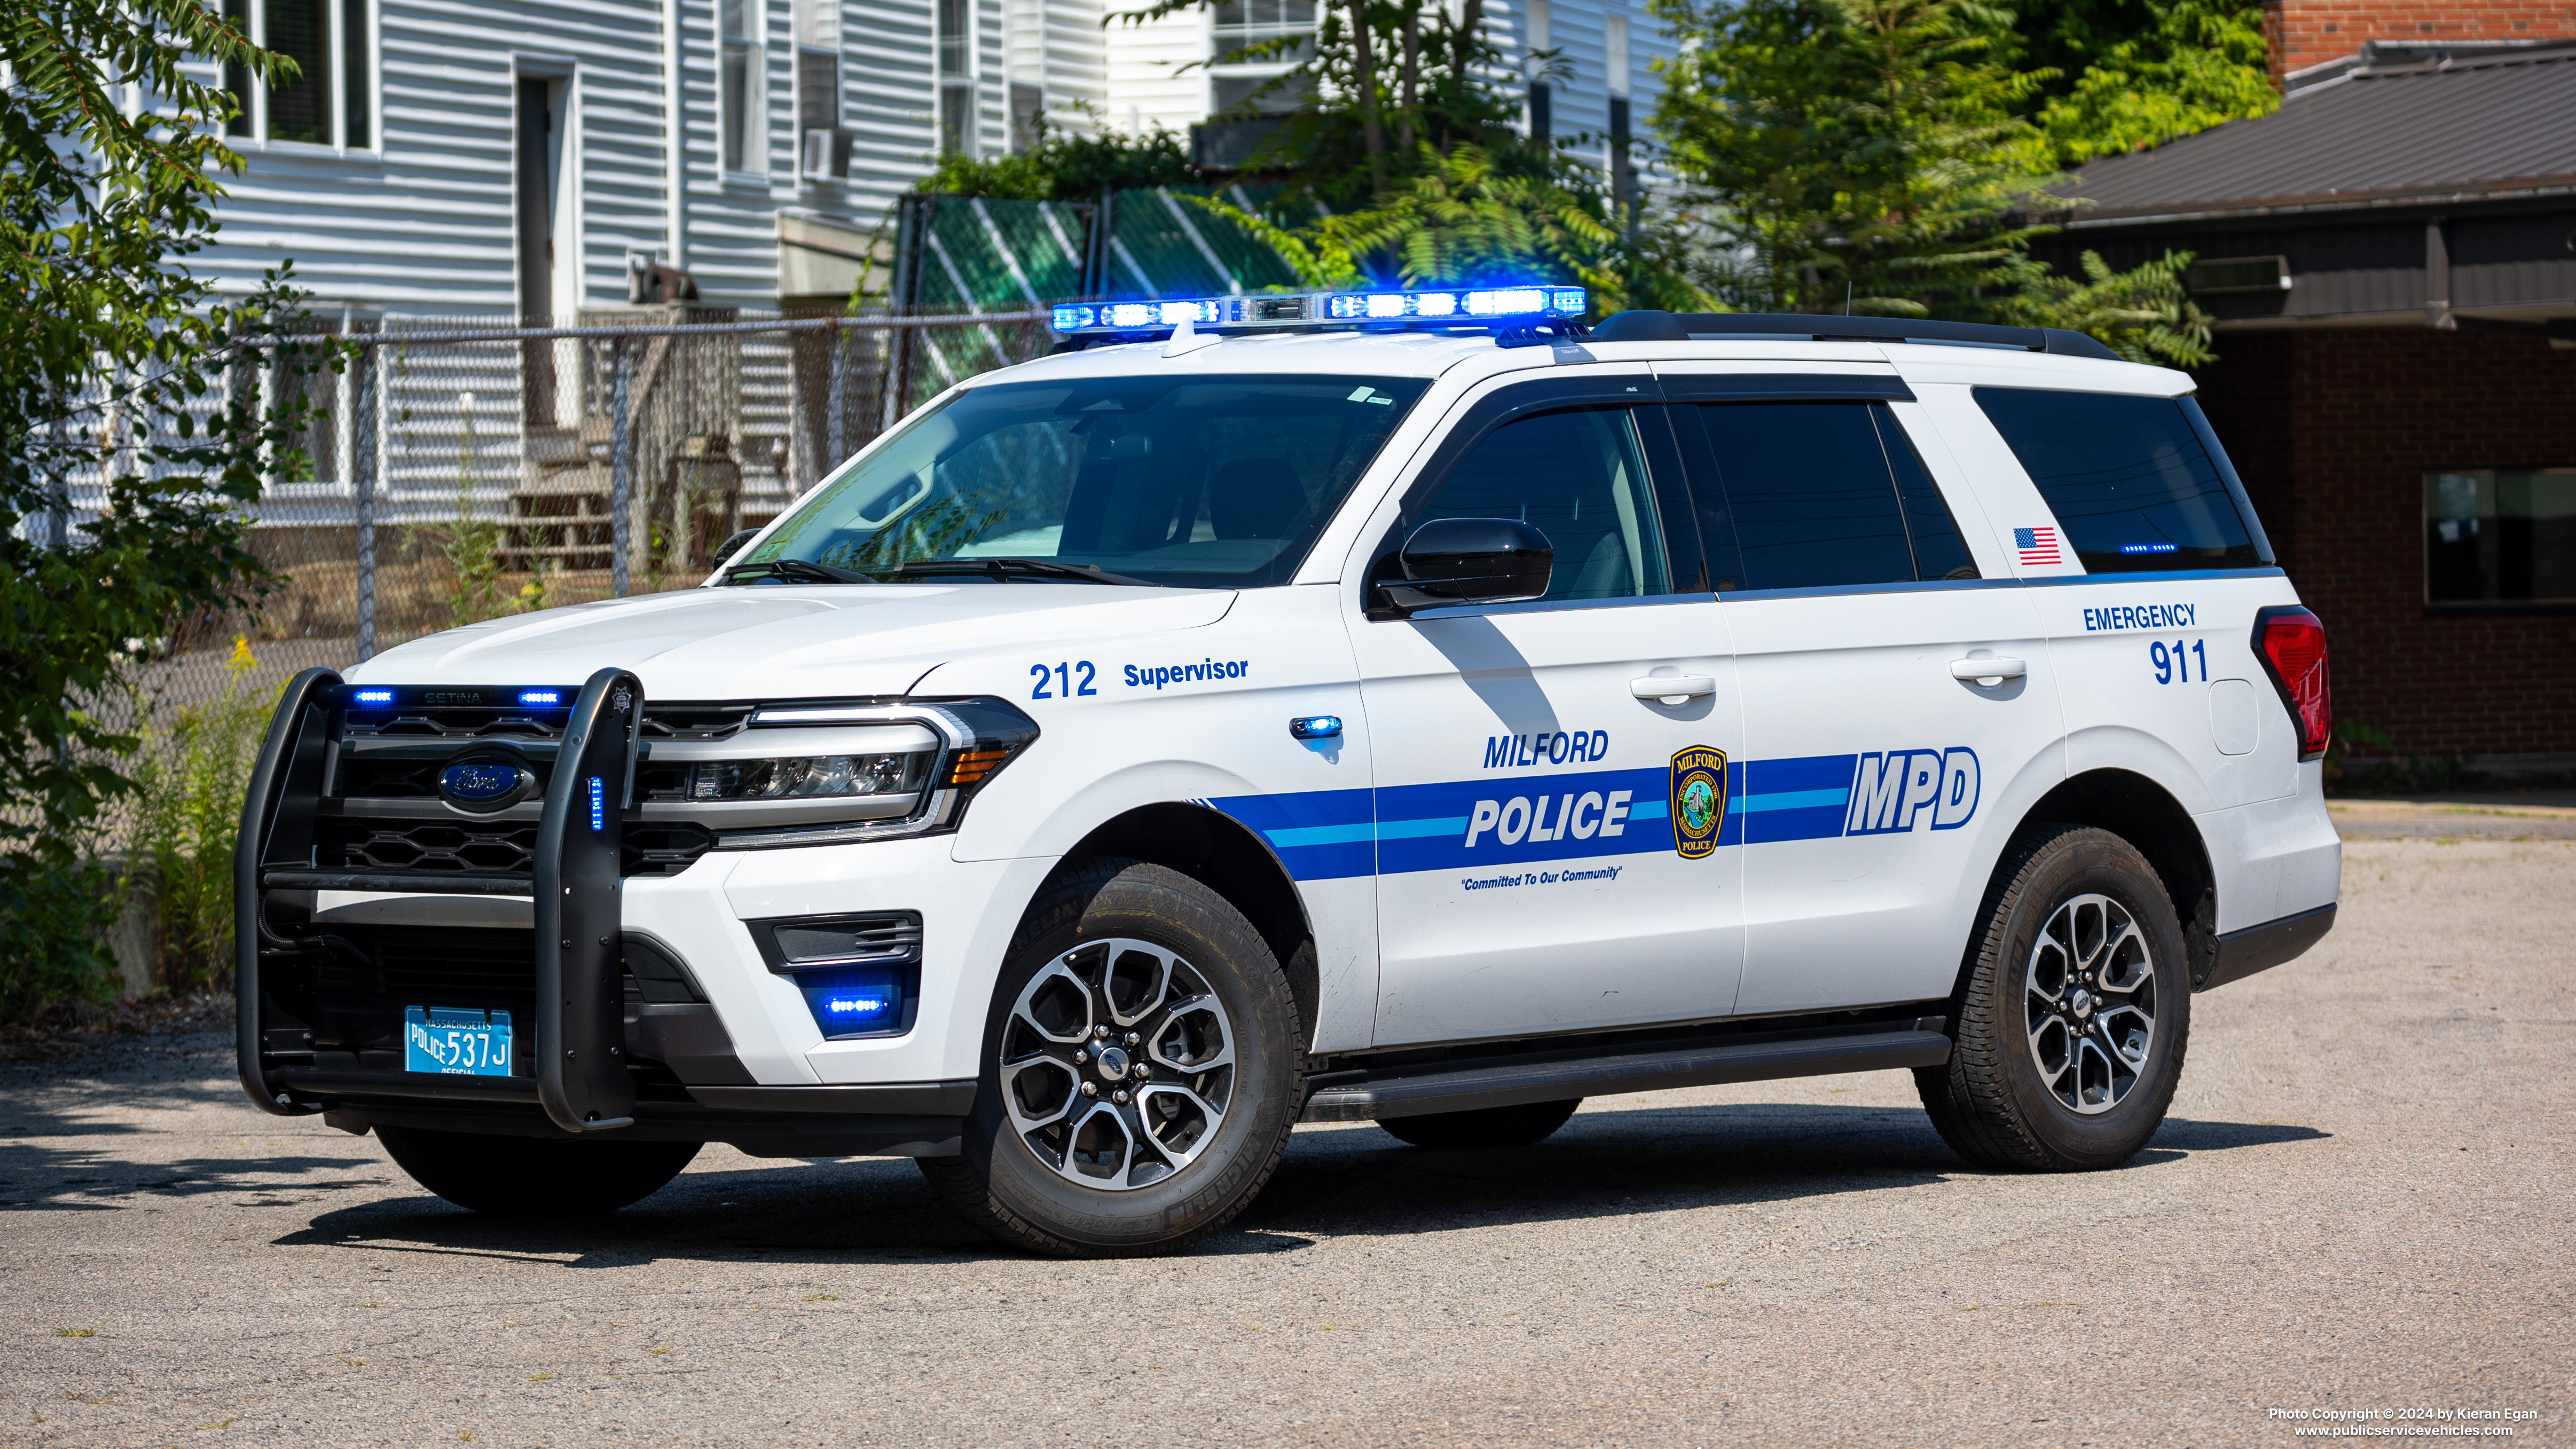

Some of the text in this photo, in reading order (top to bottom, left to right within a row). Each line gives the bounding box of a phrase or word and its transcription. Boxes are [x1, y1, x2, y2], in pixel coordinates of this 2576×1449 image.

[2084, 603, 2195, 631] EMERGENCY
[2150, 639, 2207, 685] 911
[1030, 658, 1248, 700] 212 Supervisor
[425, 692, 482, 703] SETINA
[1483, 730, 1608, 769] MILFORD
[454, 764, 502, 790] Ford
[1677, 753, 1721, 774] MILFORD
[1679, 774, 1713, 801] INCORPORATED
[1845, 746, 1981, 837] MPD
[1465, 790, 1632, 847] POLICE
[1679, 815, 1716, 837] MASSACHUSETTS
[1683, 840, 1711, 851] POLICE
[1461, 865, 1622, 891] "Committed To Our Community"
[426, 1019, 491, 1031] MASSACHUSETTS
[412, 1023, 445, 1065] POLICE
[1106, 1057, 1121, 1072] Ford
[1168, 1136, 1262, 1226] MICHELIN
